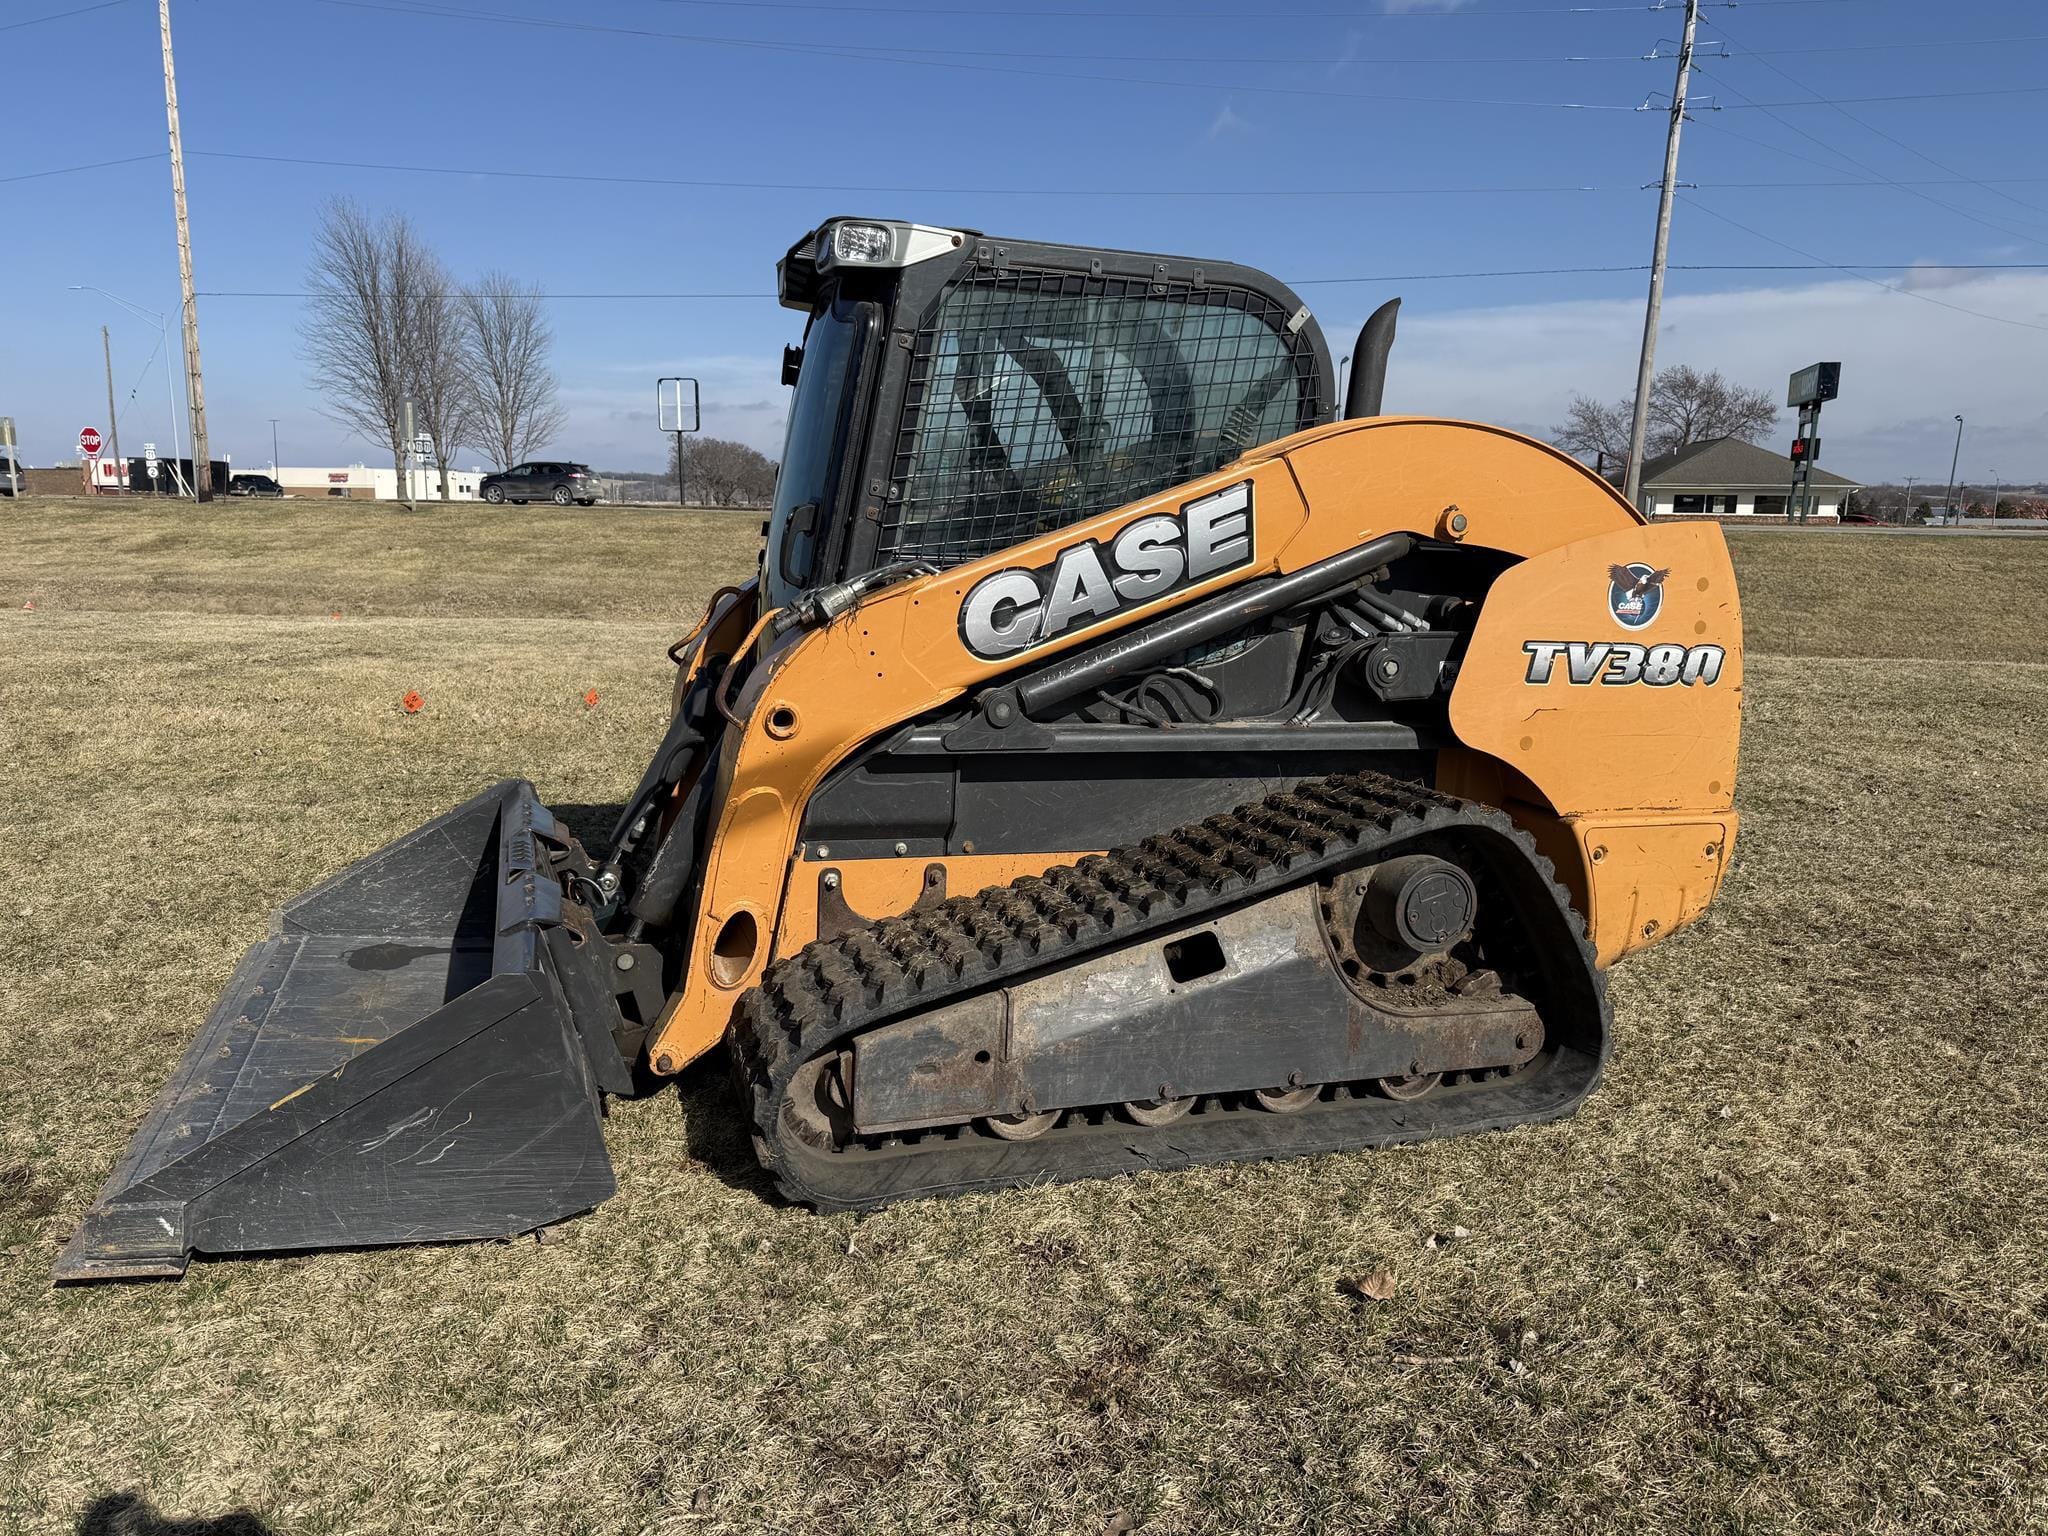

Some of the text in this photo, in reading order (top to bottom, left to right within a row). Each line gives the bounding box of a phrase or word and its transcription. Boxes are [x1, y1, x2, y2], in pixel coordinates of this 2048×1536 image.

[81, 435, 100, 445] STOP
[961, 480, 1251, 657] CASE
[1618, 602, 1644, 610] CASE
[1523, 640, 1726, 687] TV380
